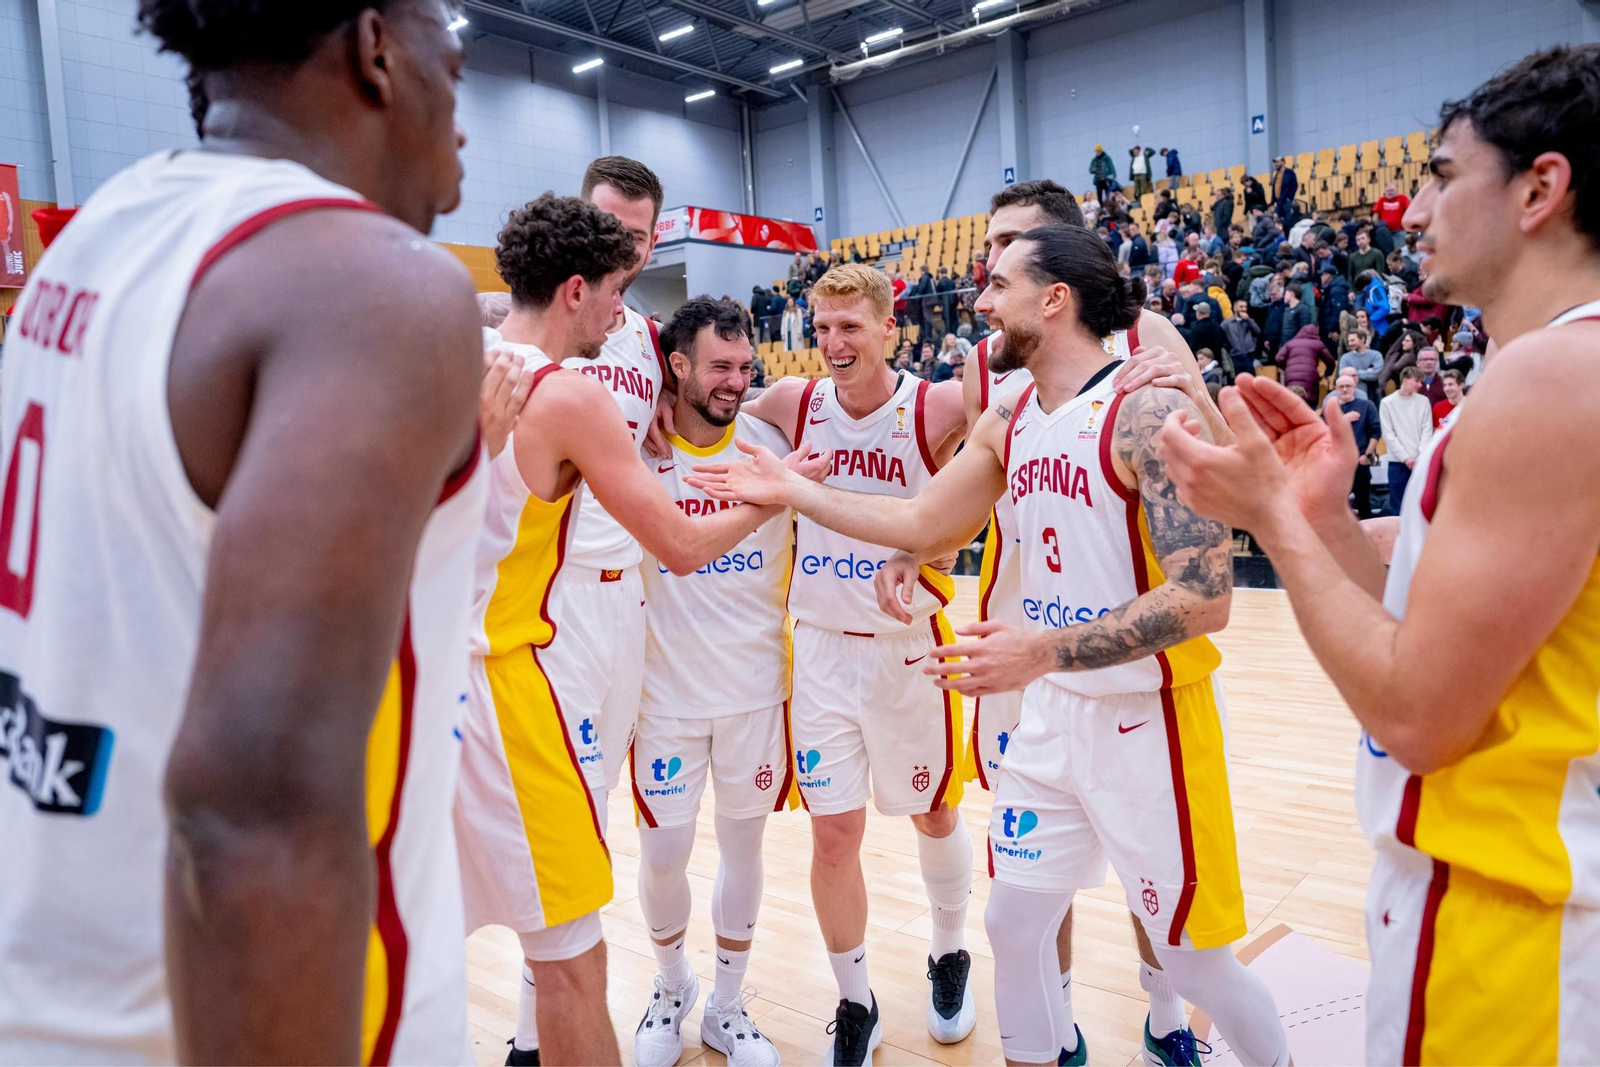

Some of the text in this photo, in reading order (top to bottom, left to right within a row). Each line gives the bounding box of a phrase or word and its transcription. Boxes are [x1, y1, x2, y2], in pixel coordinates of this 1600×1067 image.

[570, 365, 654, 409] PAÑA
[808, 448, 907, 487] PAÑA
[1011, 453, 1093, 508] ESPAÑA
[801, 553, 887, 580] ende
[1042, 527, 1062, 573] 3
